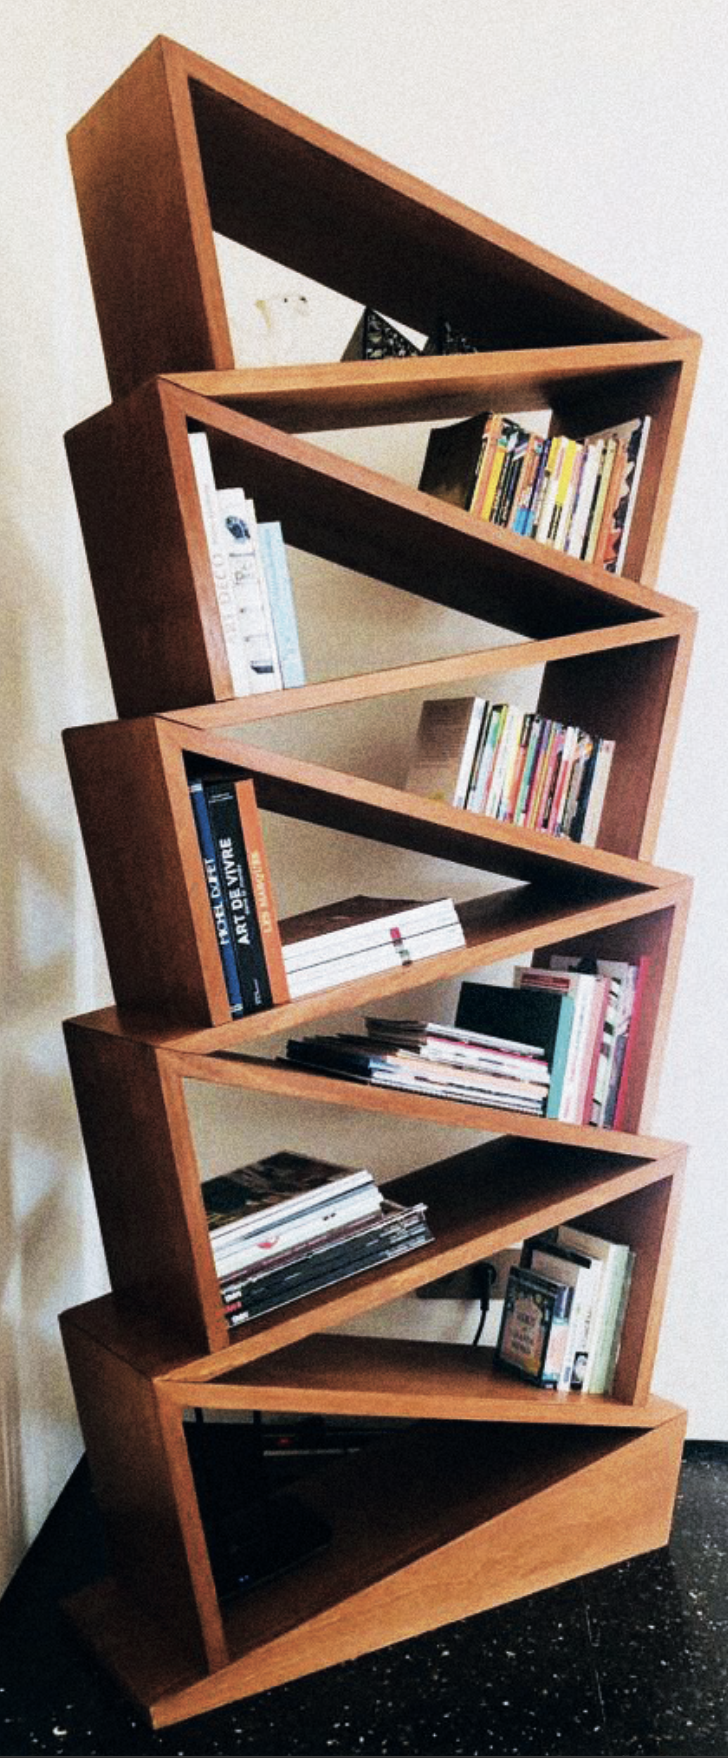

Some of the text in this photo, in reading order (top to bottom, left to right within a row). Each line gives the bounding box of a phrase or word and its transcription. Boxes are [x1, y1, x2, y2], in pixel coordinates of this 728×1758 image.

[219, 837, 238, 885] VIVRE
[228, 888, 243, 909] DE
[234, 914, 250, 945] ART
